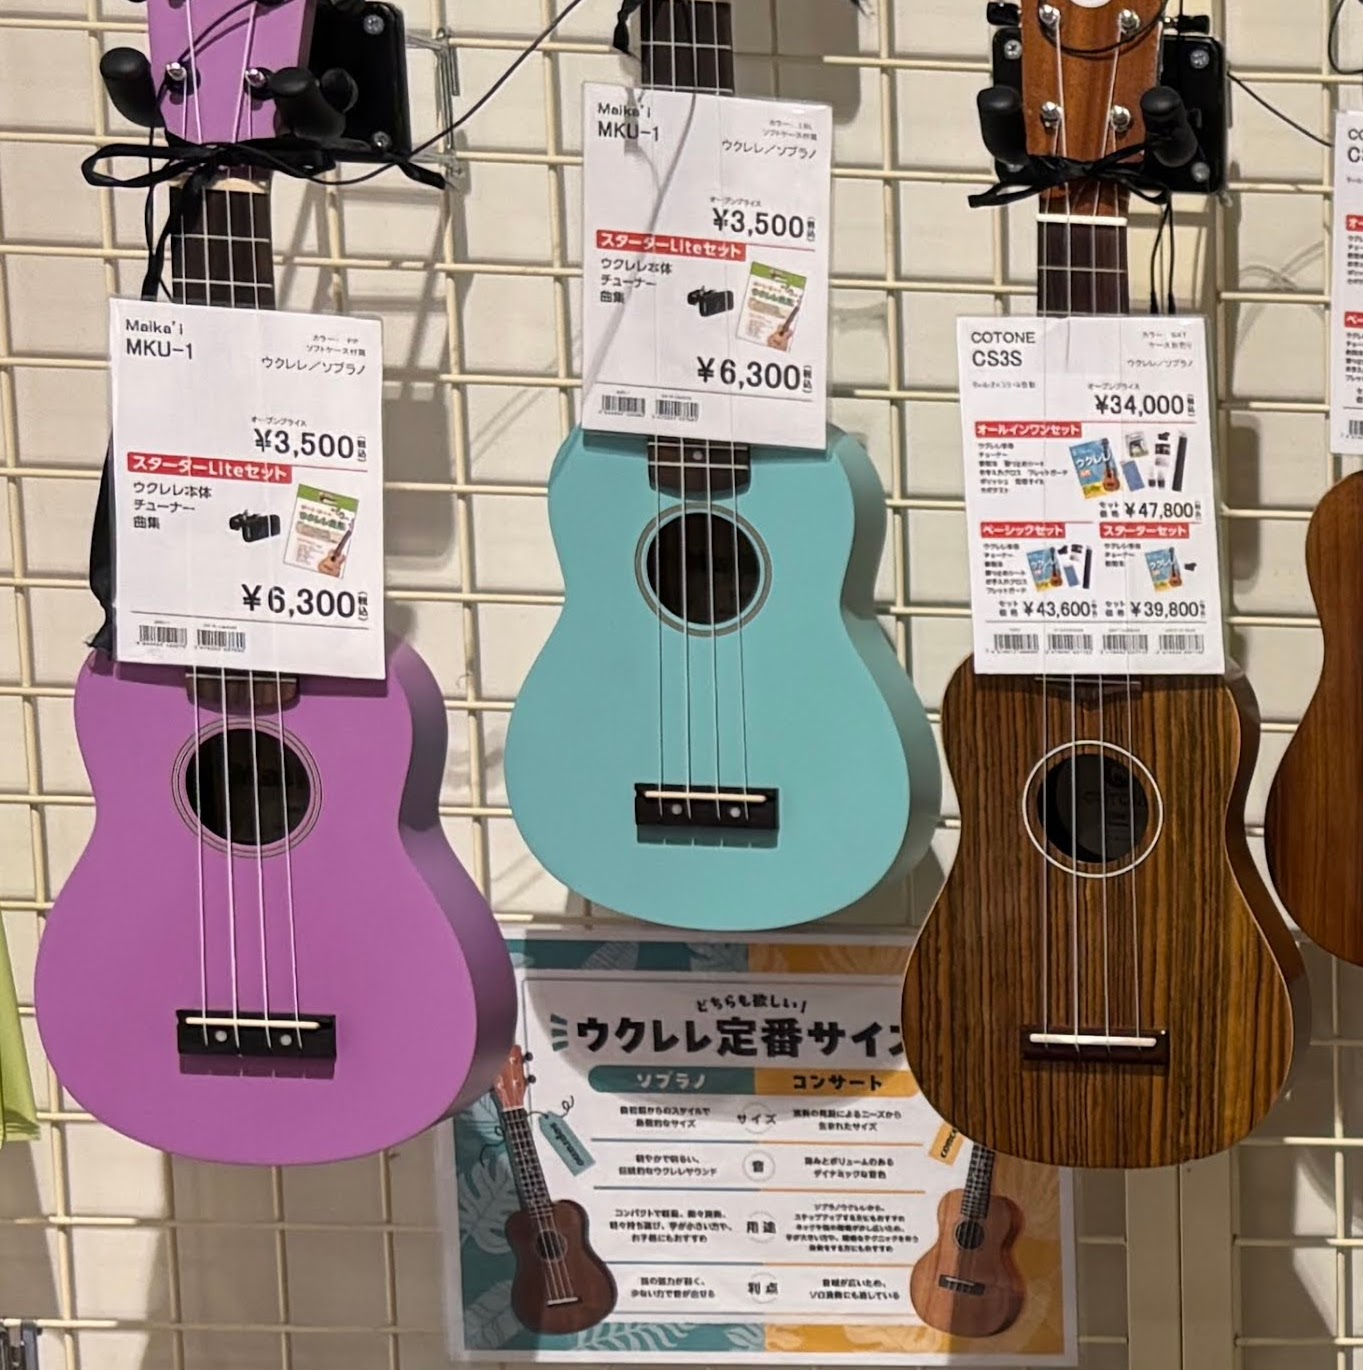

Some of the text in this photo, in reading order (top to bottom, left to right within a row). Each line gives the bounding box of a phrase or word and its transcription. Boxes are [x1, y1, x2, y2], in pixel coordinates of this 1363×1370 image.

[597, 121, 660, 142] MKU-1
[713, 208, 805, 238] ¥3,500
[601, 232, 742, 256] スターターLiteセット
[601, 274, 657, 288] チューナー
[971, 331, 1036, 344] COTONE
[126, 338, 193, 360] MKU-1
[972, 350, 1023, 368] CS3S
[1095, 394, 1184, 417] ¥34,000
[254, 428, 356, 459] ¥3,500
[132, 455, 288, 482] スターターLiteセット
[133, 482, 212, 499] ウクレレ本体
[133, 498, 196, 513] チューナー
[133, 516, 160, 531] 曲集
[636, 1072, 883, 1092] ソプラノ コンサート
[737, 1113, 777, 1125] サイズ
[752, 1161, 764, 1172] 音
[746, 1222, 776, 1234] 用途
[748, 1282, 778, 1294] 利点
